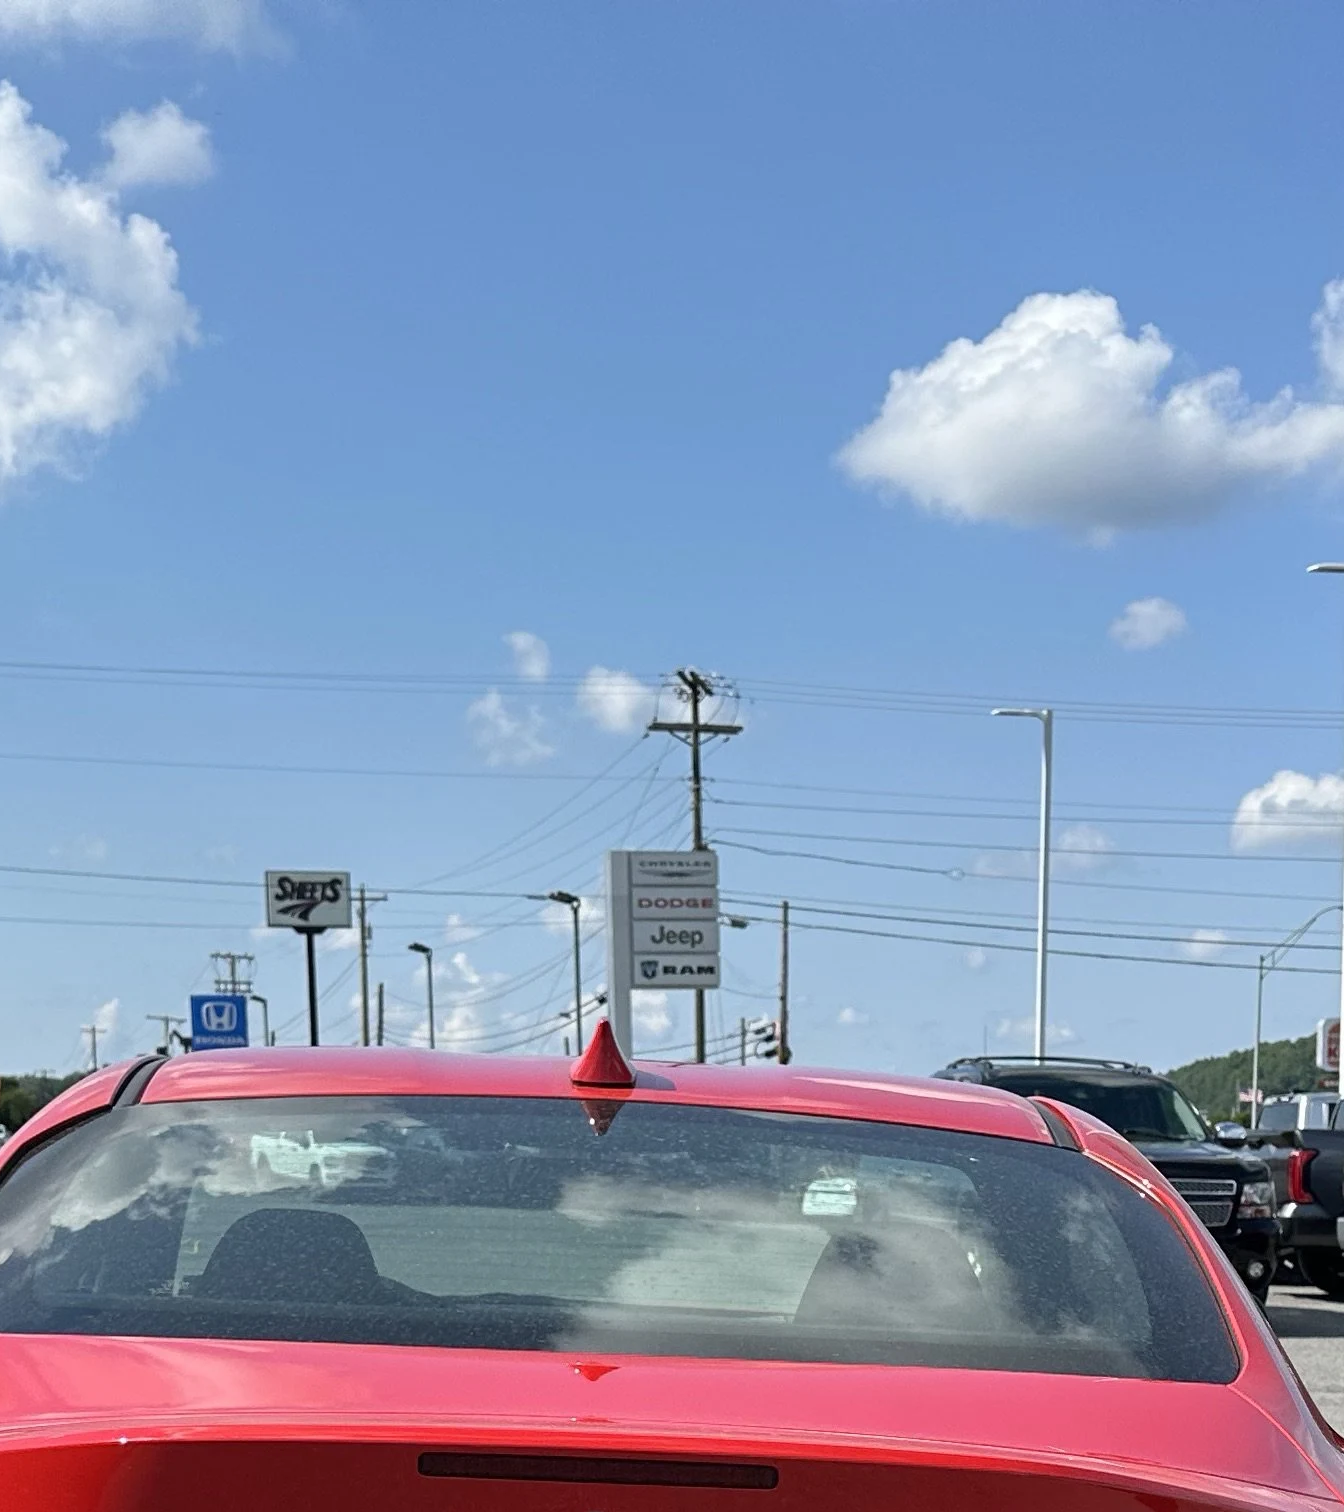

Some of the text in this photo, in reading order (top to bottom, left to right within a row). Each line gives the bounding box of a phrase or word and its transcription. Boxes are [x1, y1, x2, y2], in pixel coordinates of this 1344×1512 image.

[638, 898, 713, 909] DODGE
[650, 924, 704, 948] Jeep
[662, 965, 716, 975] RAM
